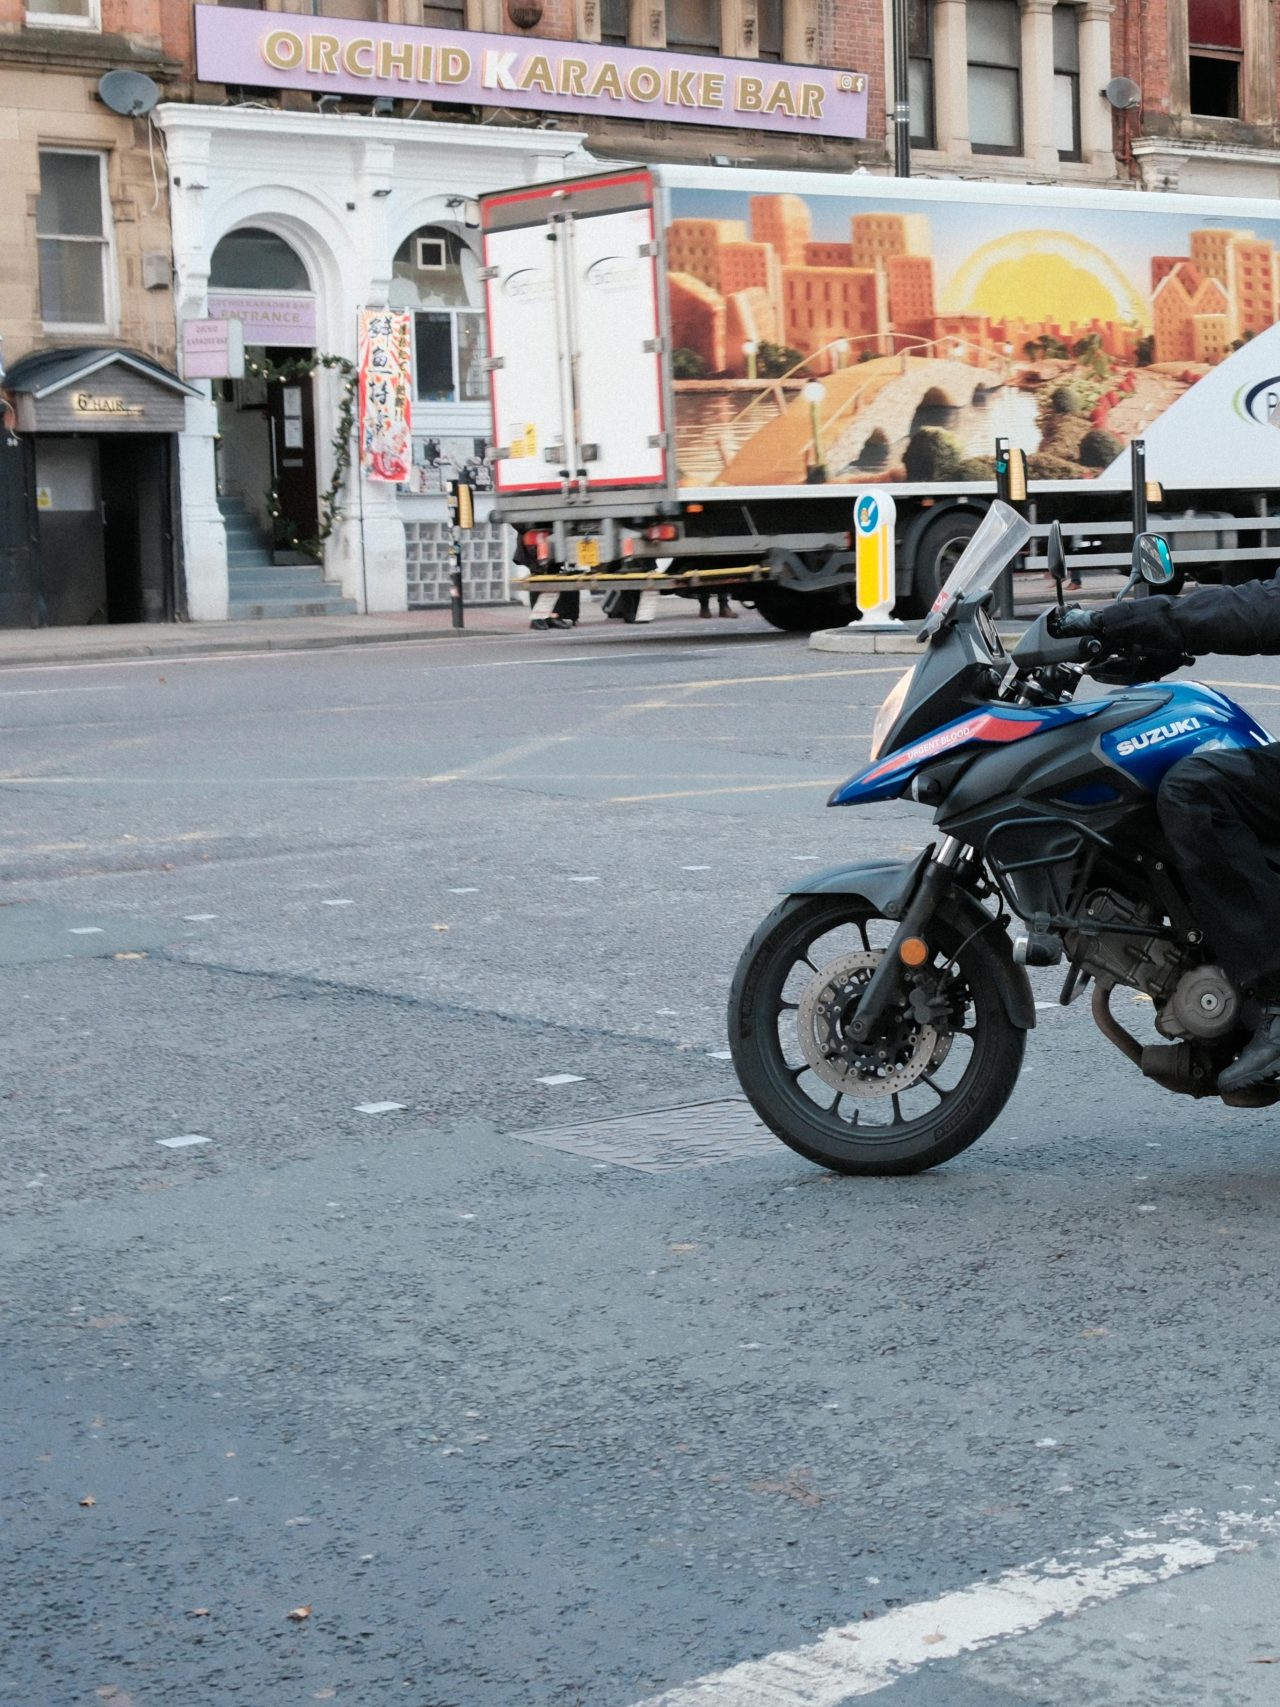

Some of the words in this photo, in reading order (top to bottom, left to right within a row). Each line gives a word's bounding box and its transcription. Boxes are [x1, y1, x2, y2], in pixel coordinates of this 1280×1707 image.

[262, 29, 471, 84] ORCHID
[482, 50, 725, 108] KARAOKE
[736, 77, 825, 119] BAR
[221, 310, 300, 322] ENTRANCE
[907, 739, 940, 760] URGENT
[940, 727, 970, 745] BLOOD
[1116, 717, 1201, 756] SUZUKI
